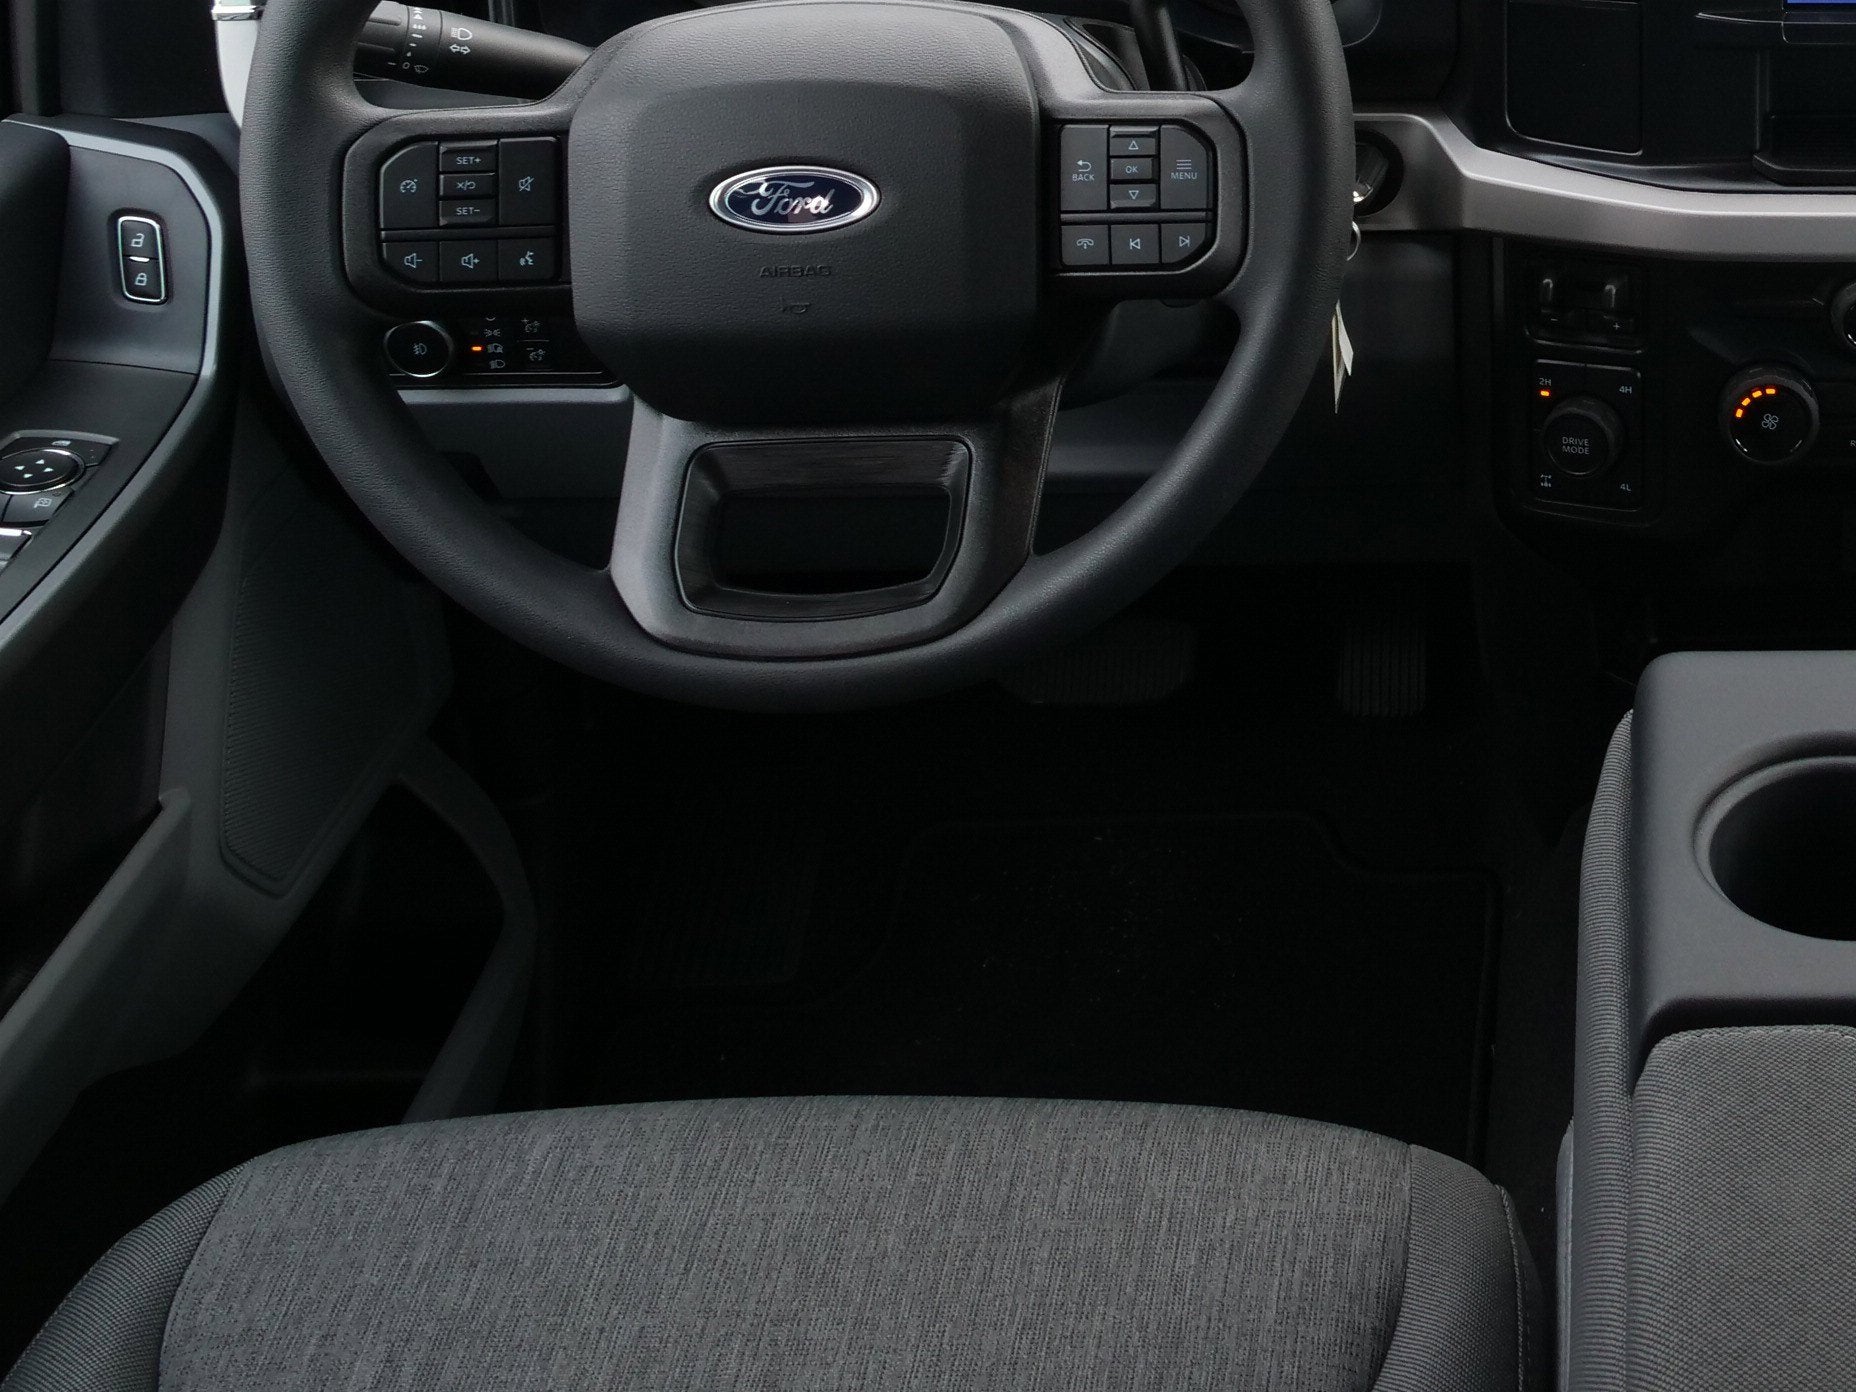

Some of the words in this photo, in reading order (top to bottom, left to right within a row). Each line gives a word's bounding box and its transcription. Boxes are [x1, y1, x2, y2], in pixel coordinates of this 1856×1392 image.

[1125, 165, 1139, 174] OK
[1072, 173, 1095, 182] BACK
[1170, 172, 1198, 180] MENU
[760, 264, 832, 278] AIRBAG
[1539, 378, 1552, 386] 2H
[1618, 385, 1633, 395] 4H
[1561, 436, 1590, 447] DRIVE
[1561, 445, 1590, 455] MODE
[1620, 483, 1632, 492] 4L
